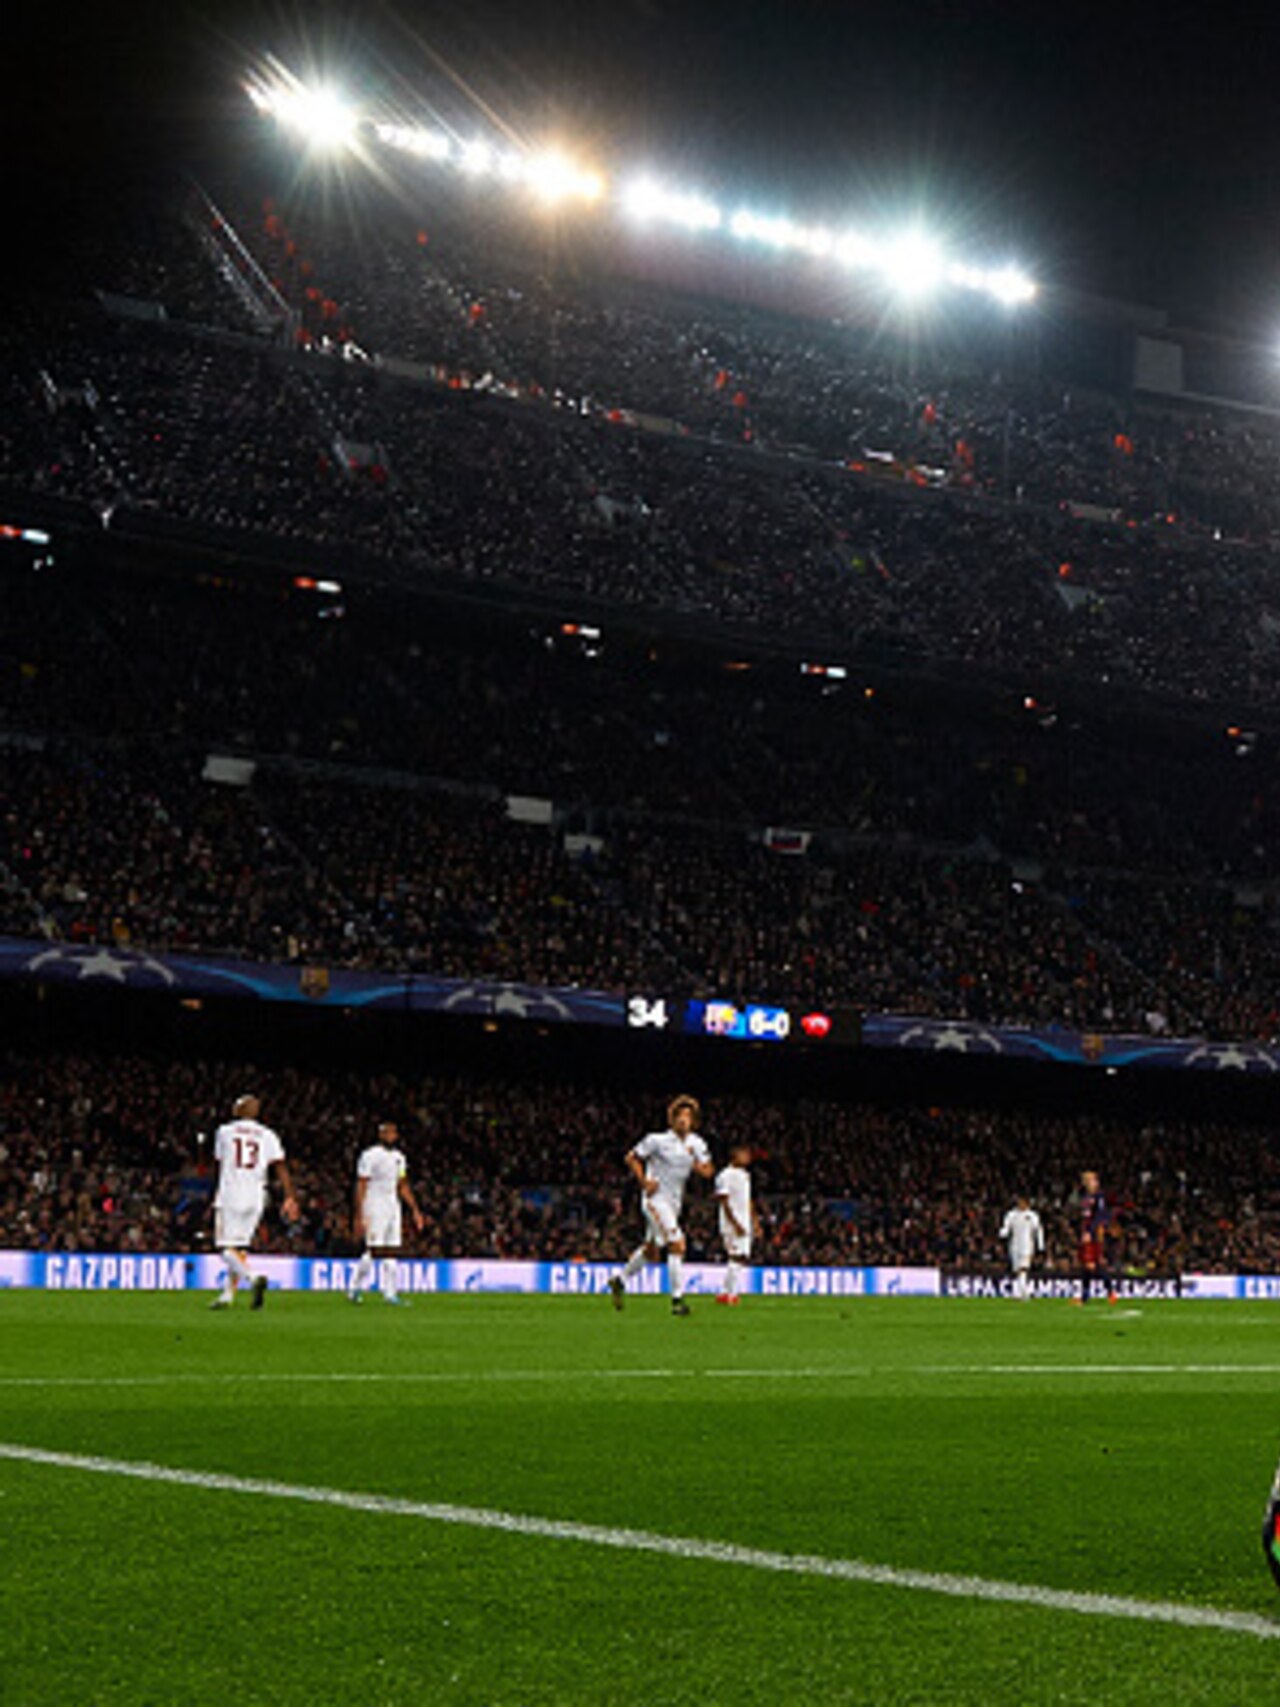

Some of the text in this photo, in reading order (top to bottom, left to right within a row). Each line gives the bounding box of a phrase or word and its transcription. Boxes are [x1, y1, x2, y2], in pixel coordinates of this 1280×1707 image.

[628, 997, 668, 1028] 34
[749, 1008, 790, 1038] 6-0
[232, 1138, 260, 1170] 13
[46, 1256, 186, 1290] GAZPROM
[311, 1261, 437, 1292] GAZPOM
